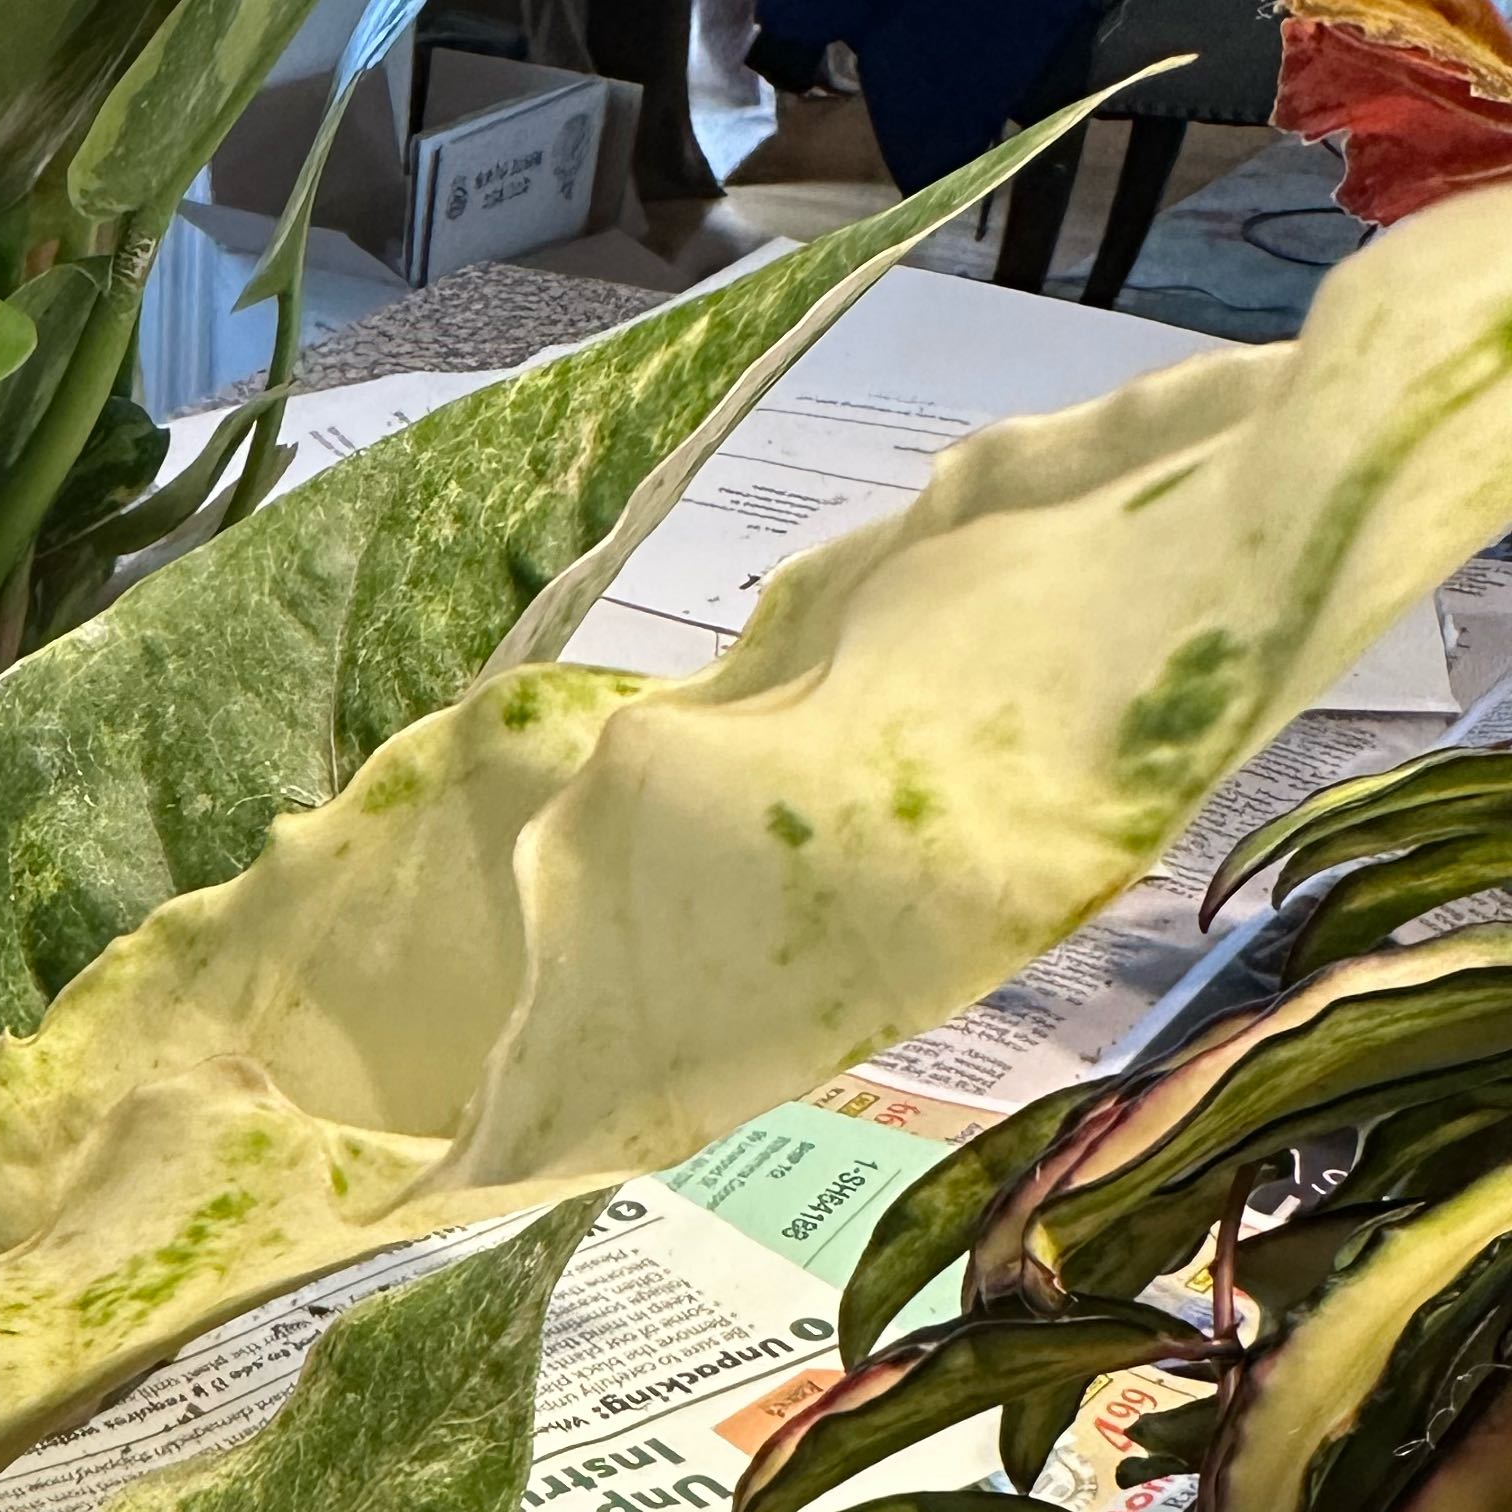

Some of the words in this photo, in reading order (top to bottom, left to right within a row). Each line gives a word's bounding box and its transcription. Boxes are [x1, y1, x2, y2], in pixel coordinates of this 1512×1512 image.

[585, 1314, 629, 1342] mind
[655, 1314, 733, 1350] Remove
[723, 1326, 751, 1343] Be
[626, 1340, 656, 1361] the
[658, 1350, 682, 1367] to
[682, 1336, 721, 1358] sure
[573, 1353, 626, 1382] black
[581, 1359, 657, 1397] carefully
[590, 1336, 795, 1420] Unpacking:
[535, 1374, 573, 1397] pla
